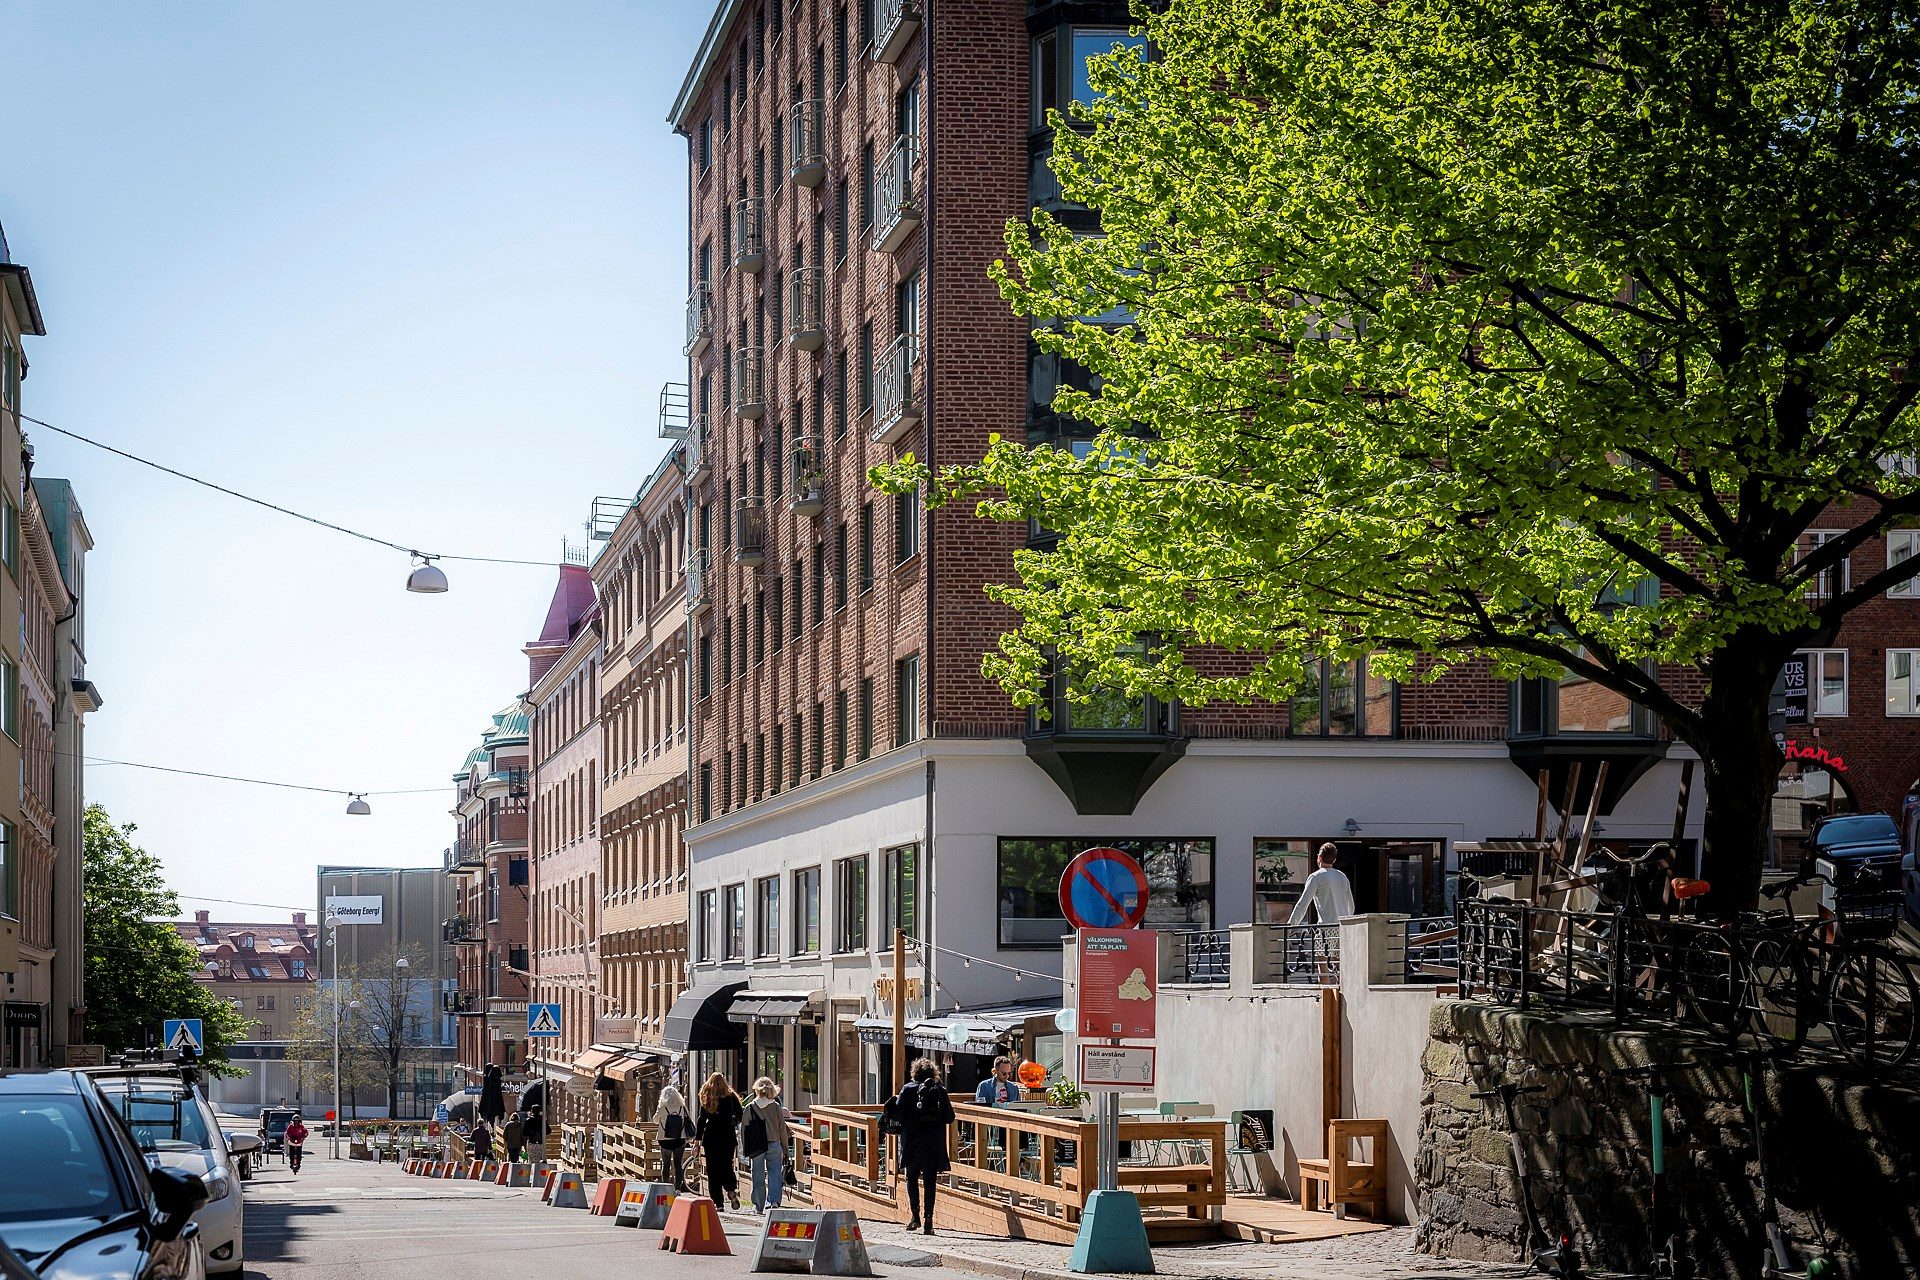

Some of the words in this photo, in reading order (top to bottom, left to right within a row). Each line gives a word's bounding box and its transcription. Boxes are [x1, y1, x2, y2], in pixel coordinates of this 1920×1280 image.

[1785, 739, 1849, 771] ñana
[337, 906, 361, 916] Göteborg
[362, 906, 380, 916] Energi
[5, 1008, 37, 1020] Doors
[1100, 1050, 1126, 1058] avstånd
[773, 1243, 802, 1254] Ramudden
